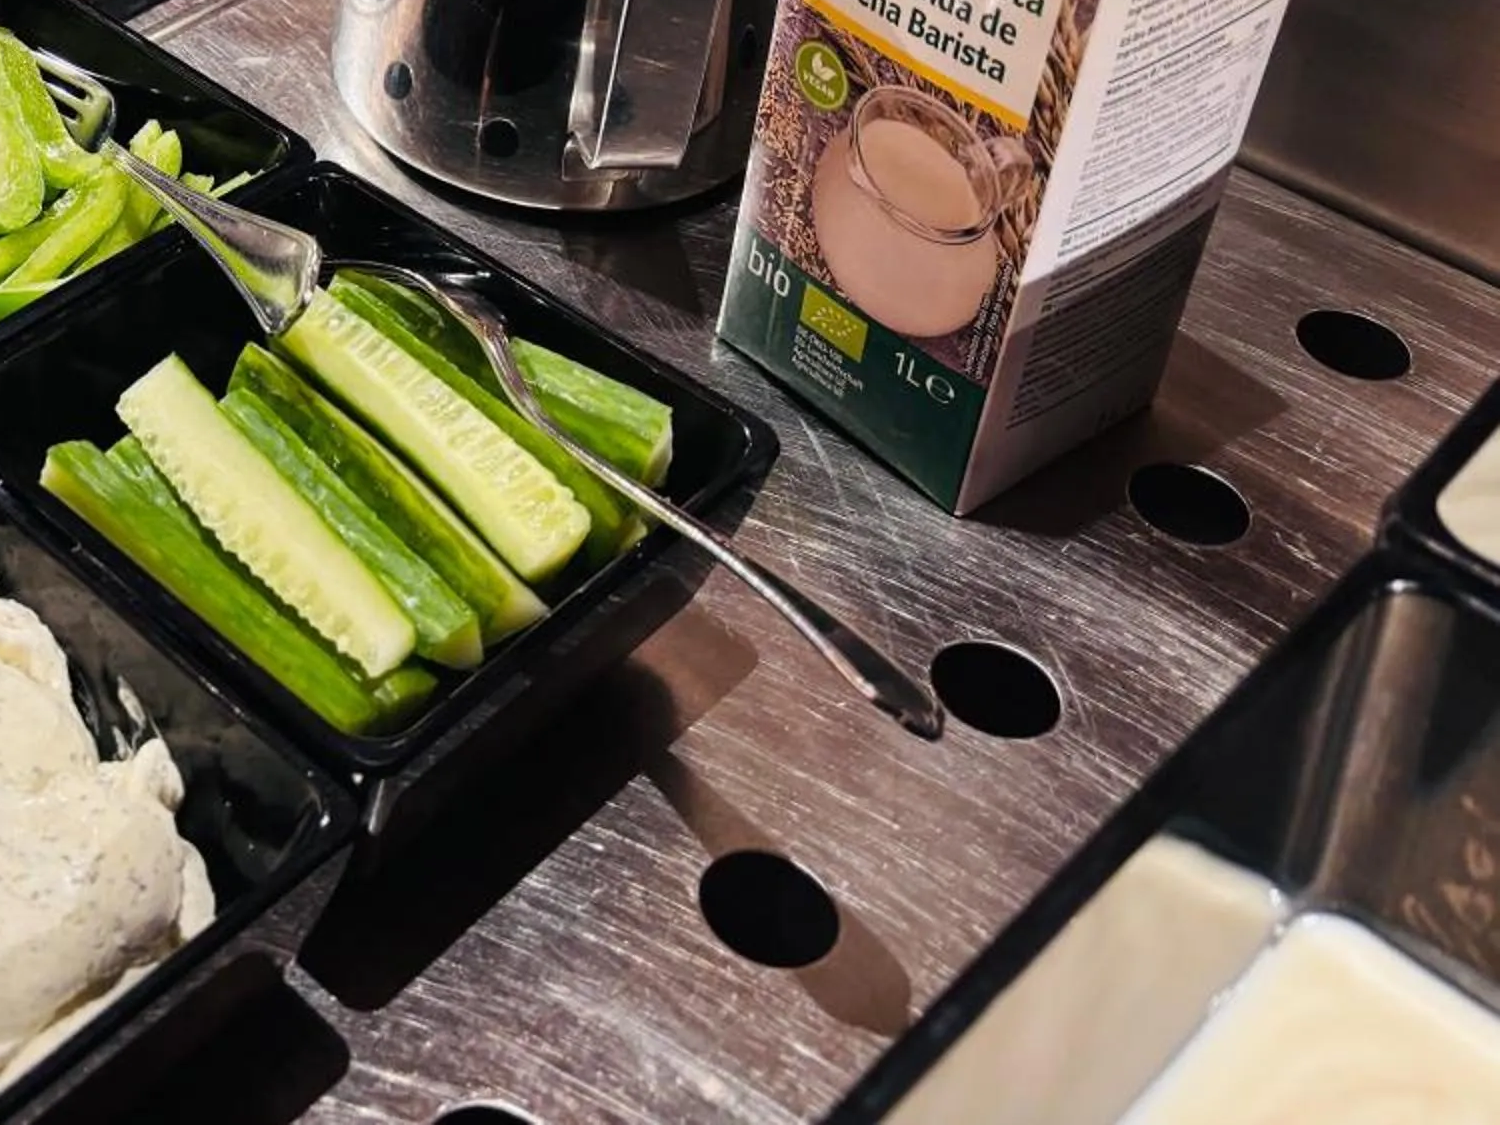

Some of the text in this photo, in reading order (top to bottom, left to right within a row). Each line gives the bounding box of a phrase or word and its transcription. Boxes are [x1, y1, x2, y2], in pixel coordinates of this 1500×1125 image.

[906, 7, 1006, 84] Barista
[979, 7, 1018, 46] de
[747, 238, 790, 298] bio
[894, 351, 922, 389] 1L
